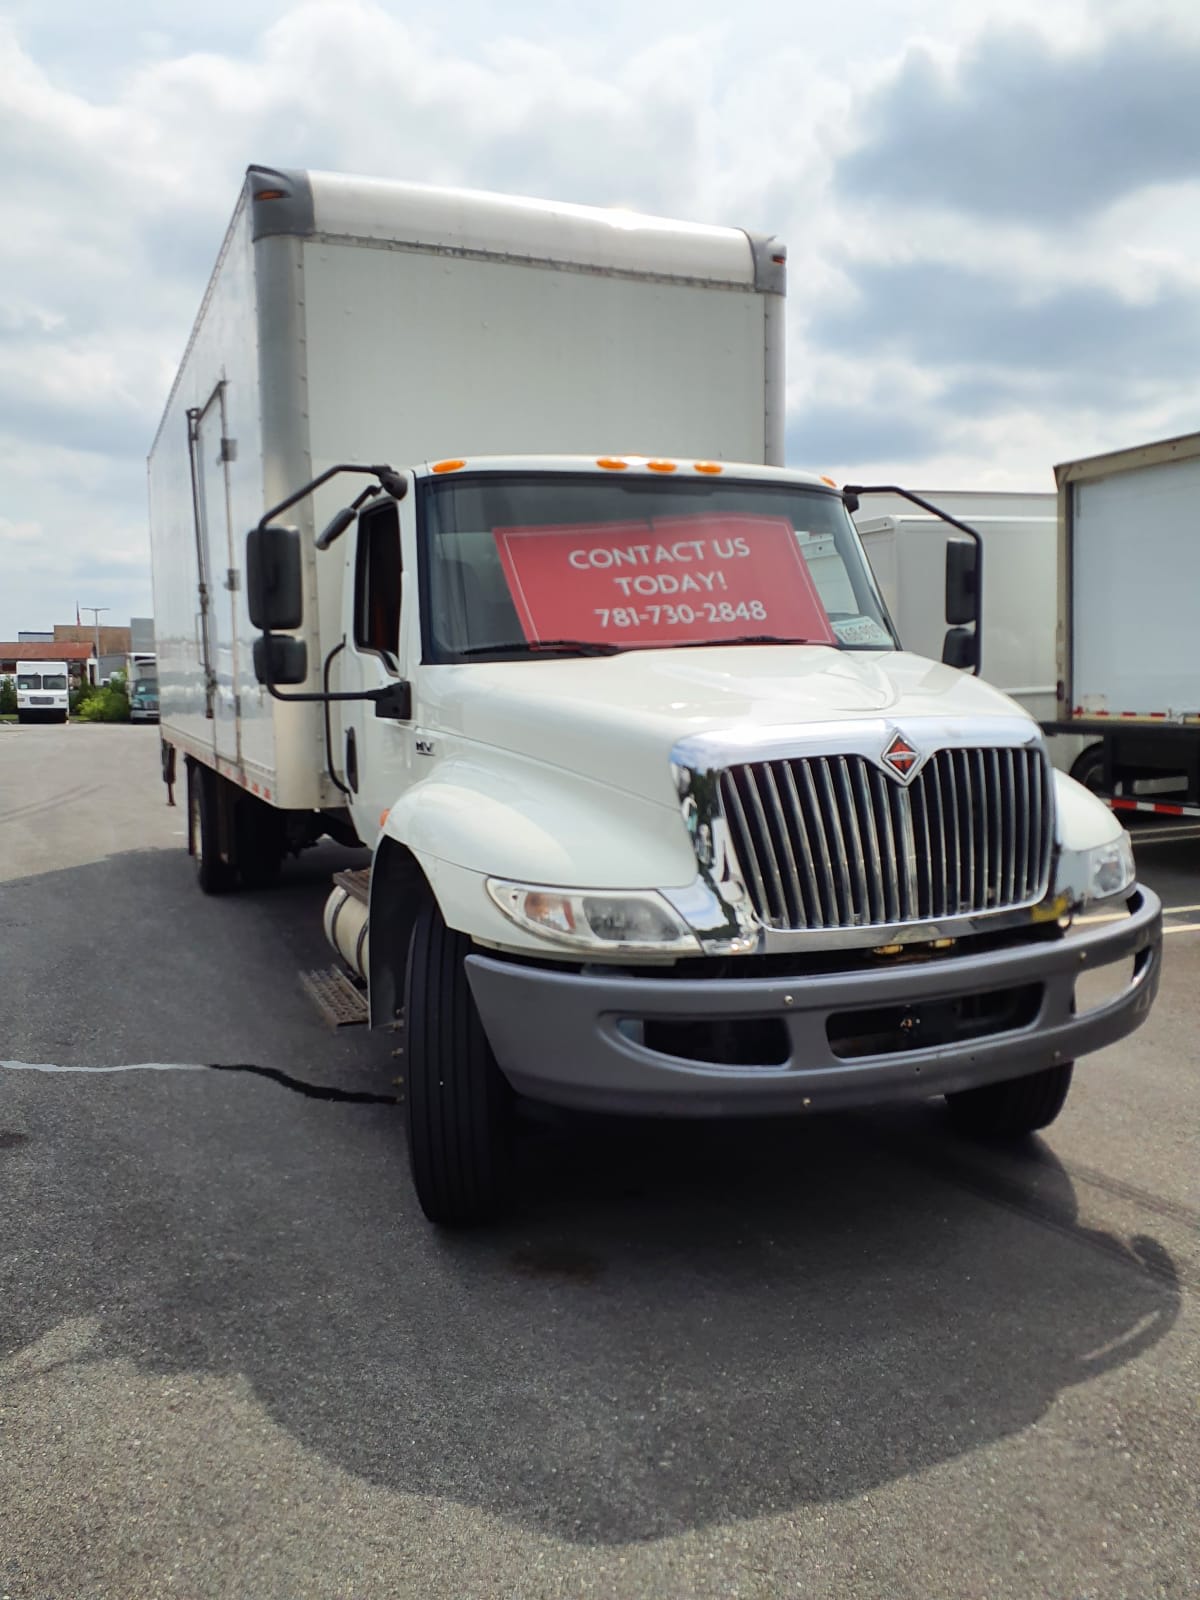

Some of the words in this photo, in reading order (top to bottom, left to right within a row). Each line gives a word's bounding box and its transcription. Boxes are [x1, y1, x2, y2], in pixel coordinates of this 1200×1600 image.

[568, 540, 705, 570] CONTACT
[712, 537, 751, 558] US
[613, 571, 728, 597] TODAY!
[595, 600, 768, 628] 781-730-2848
